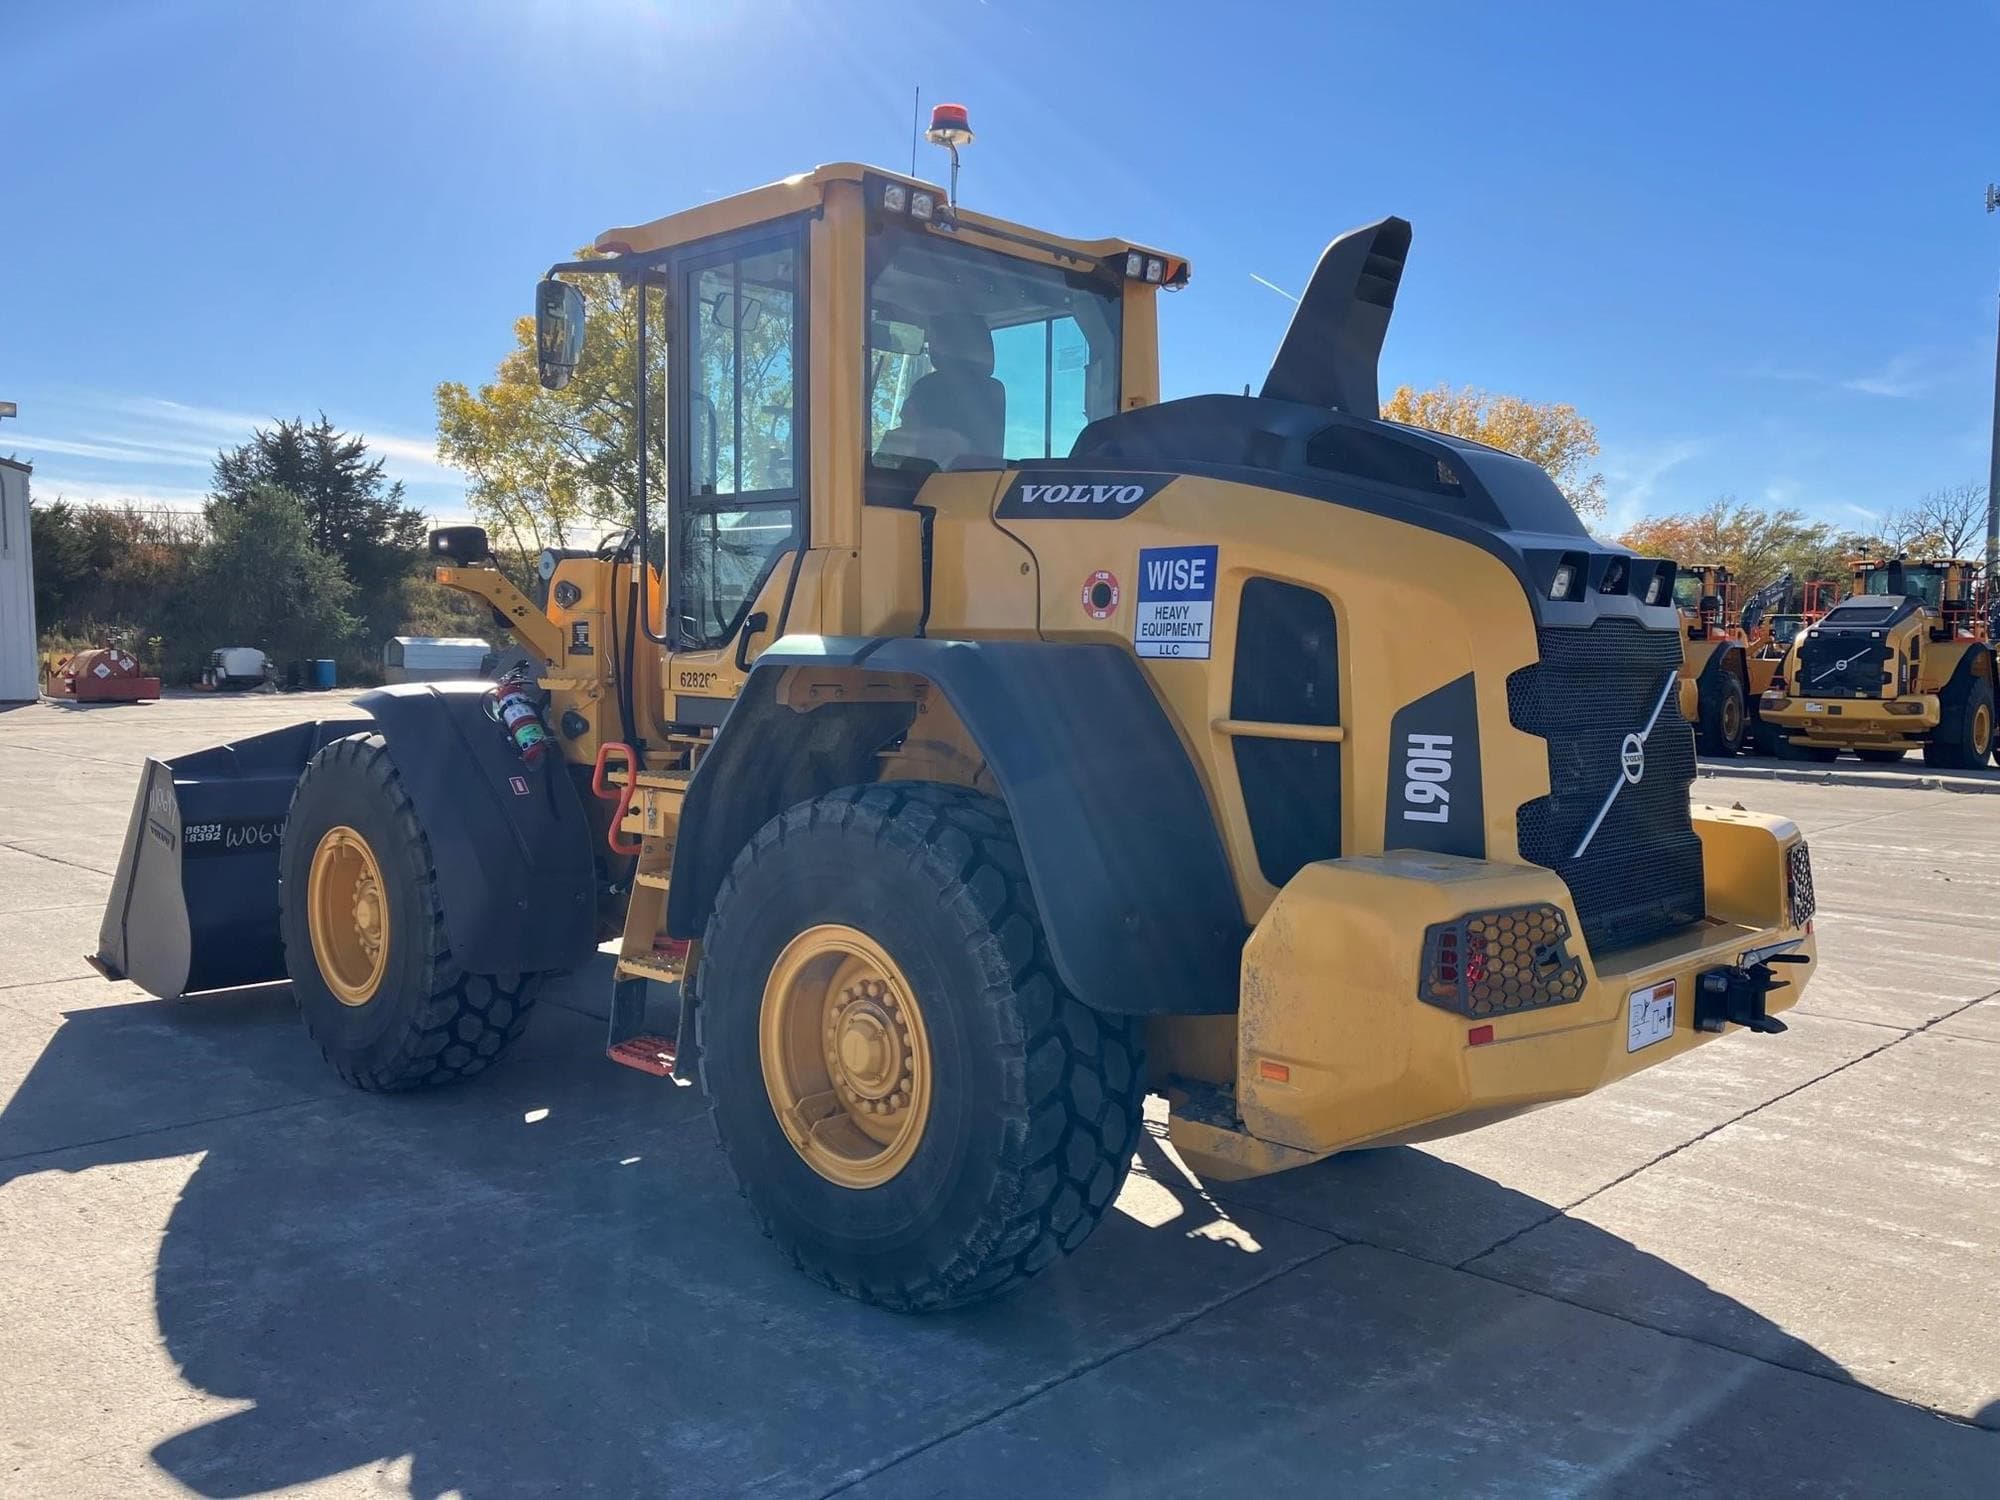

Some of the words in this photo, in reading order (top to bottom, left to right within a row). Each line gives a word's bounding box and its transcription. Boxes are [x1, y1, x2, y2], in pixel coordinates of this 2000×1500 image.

[1021, 484, 1144, 503] VOLVO
[1147, 559, 1206, 591] WISE
[1155, 606, 1190, 620] HEAVY
[1141, 622, 1204, 637] EQUIPMENT
[1159, 644, 1180, 655] LLC
[1403, 734, 1453, 823] L90H
